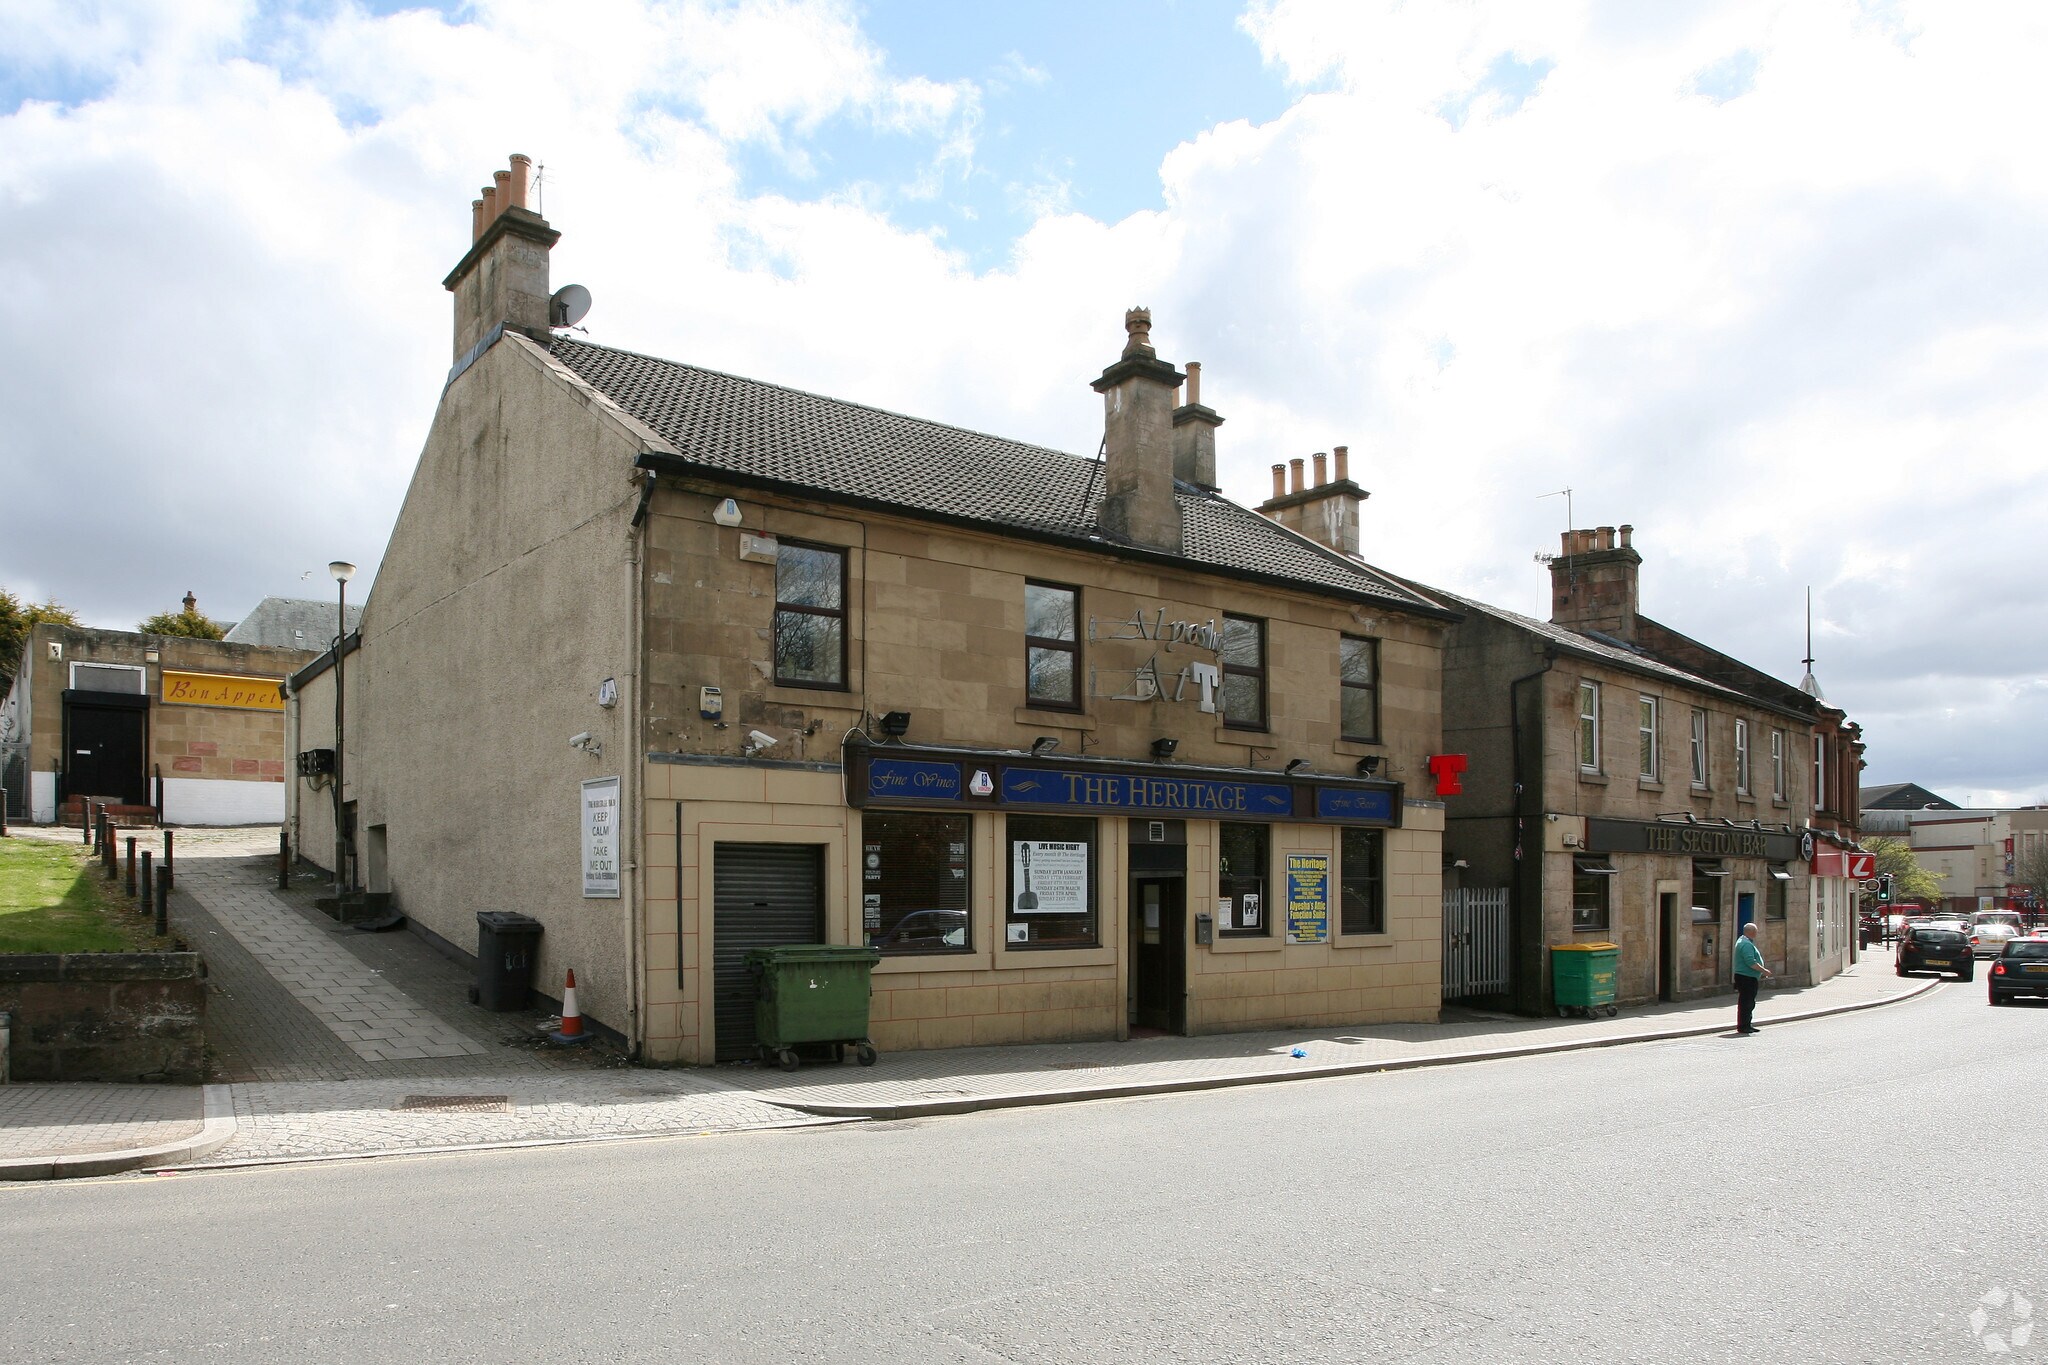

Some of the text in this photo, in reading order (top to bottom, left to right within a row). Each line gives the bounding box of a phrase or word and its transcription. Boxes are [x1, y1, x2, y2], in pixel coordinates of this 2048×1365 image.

[169, 681, 209, 699] Bon
[872, 770, 956, 788] Fine Wines
[1430, 754, 1466, 795] T
[1062, 774, 1247, 811] THE HERITAGE
[592, 812, 608, 822] KEEP
[592, 826, 609, 836] CALM
[1680, 828, 1739, 854] SEGTON
[1742, 834, 1768, 855] BAR
[593, 846, 608, 856] TAKE
[590, 861, 612, 870] ME OUT
[1290, 858, 1326, 870] The Heritage
